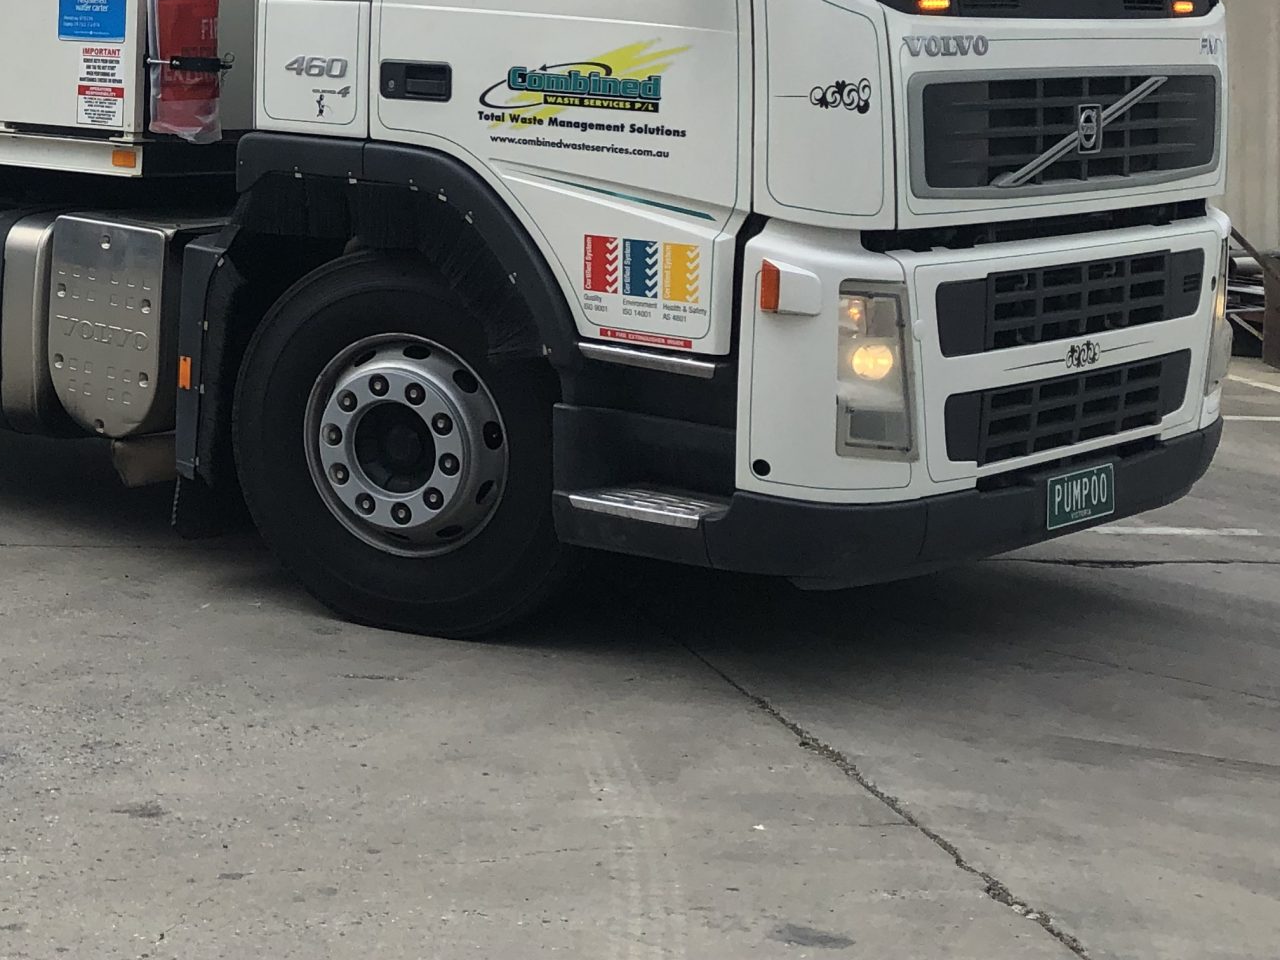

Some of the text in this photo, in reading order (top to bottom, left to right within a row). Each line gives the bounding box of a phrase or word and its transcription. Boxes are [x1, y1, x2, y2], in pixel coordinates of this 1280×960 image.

[83, 48, 121, 56] IMPORTANT
[902, 35, 989, 57] VOLVO
[284, 54, 348, 78] 460
[337, 85, 351, 98] 4
[507, 66, 662, 100] Combined
[546, 96, 654, 111] WASTE SERVICES P/L
[477, 111, 687, 138] Total Waste Management Solutions
[490, 135, 669, 158] www.combinedwasteservices.com.au
[585, 237, 593, 260] System
[624, 241, 632, 265] System
[584, 293, 602, 303] Quality
[623, 299, 657, 309] Environment
[594, 304, 608, 312] 9001
[623, 308, 651, 318] ISO 14001
[663, 303, 707, 316] Health & Safety
[56, 314, 148, 352] VOLVO
